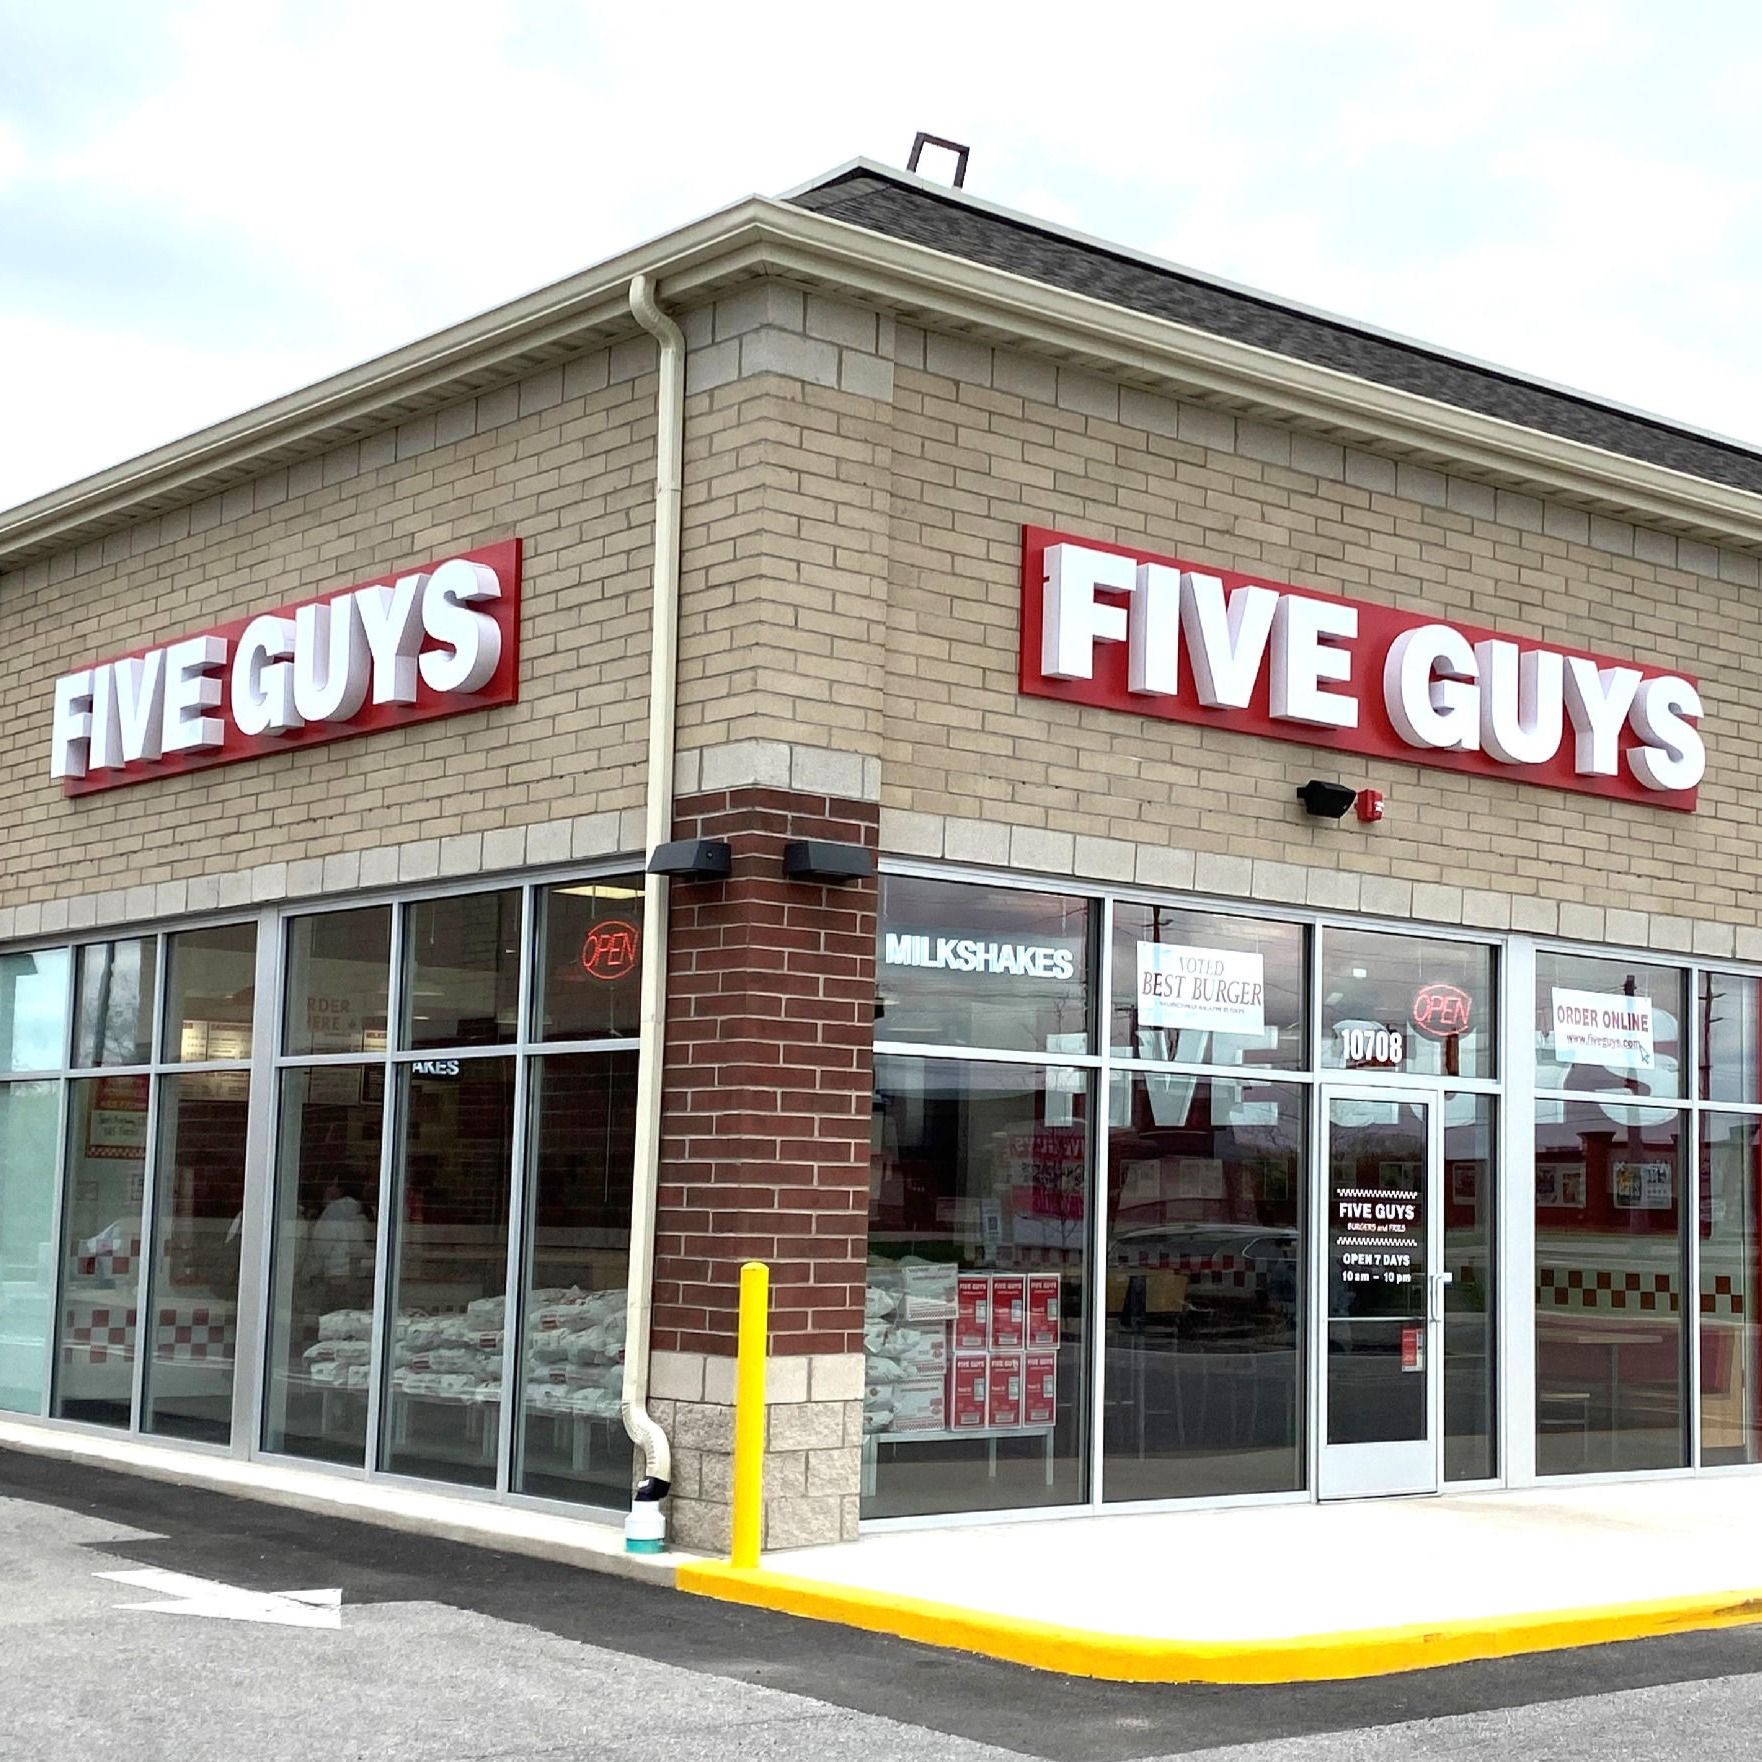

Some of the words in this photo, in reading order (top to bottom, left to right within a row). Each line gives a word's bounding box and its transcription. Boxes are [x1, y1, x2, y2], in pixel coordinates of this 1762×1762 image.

[50, 635, 228, 780] FIVE
[230, 558, 502, 737] GUYS
[1040, 541, 1360, 730] FIVE
[1383, 622, 1707, 792] GUYS
[582, 931, 639, 967] OPEN
[885, 933, 1075, 980] MILKSHAKES
[1179, 956, 1225, 976] VOTED
[1142, 971, 1186, 999] BEST
[1191, 976, 1262, 1007] BURGER
[307, 998, 350, 1013] RDER
[1413, 994, 1472, 1025] OPEN
[1557, 1004, 1599, 1029] ORDER
[1602, 1010, 1649, 1033] ONLINE
[1341, 1028, 1403, 1063] 10708
[1566, 1033, 1640, 1050] www.fiveguys.com
[1339, 1203, 1372, 1219] FIVE
[1375, 1203, 1414, 1220] GUYS
[1347, 1223, 1376, 1232] BURGERS
[1342, 1253, 1372, 1265] OPEN
[1374, 1254, 1381, 1265] 7
[1383, 1254, 1410, 1266] DAYS
[1342, 1271, 1353, 1281] 10
[1354, 1273, 1369, 1281] am
[1384, 1272, 1395, 1282] 10
[1396, 1273, 1412, 1284] pm
